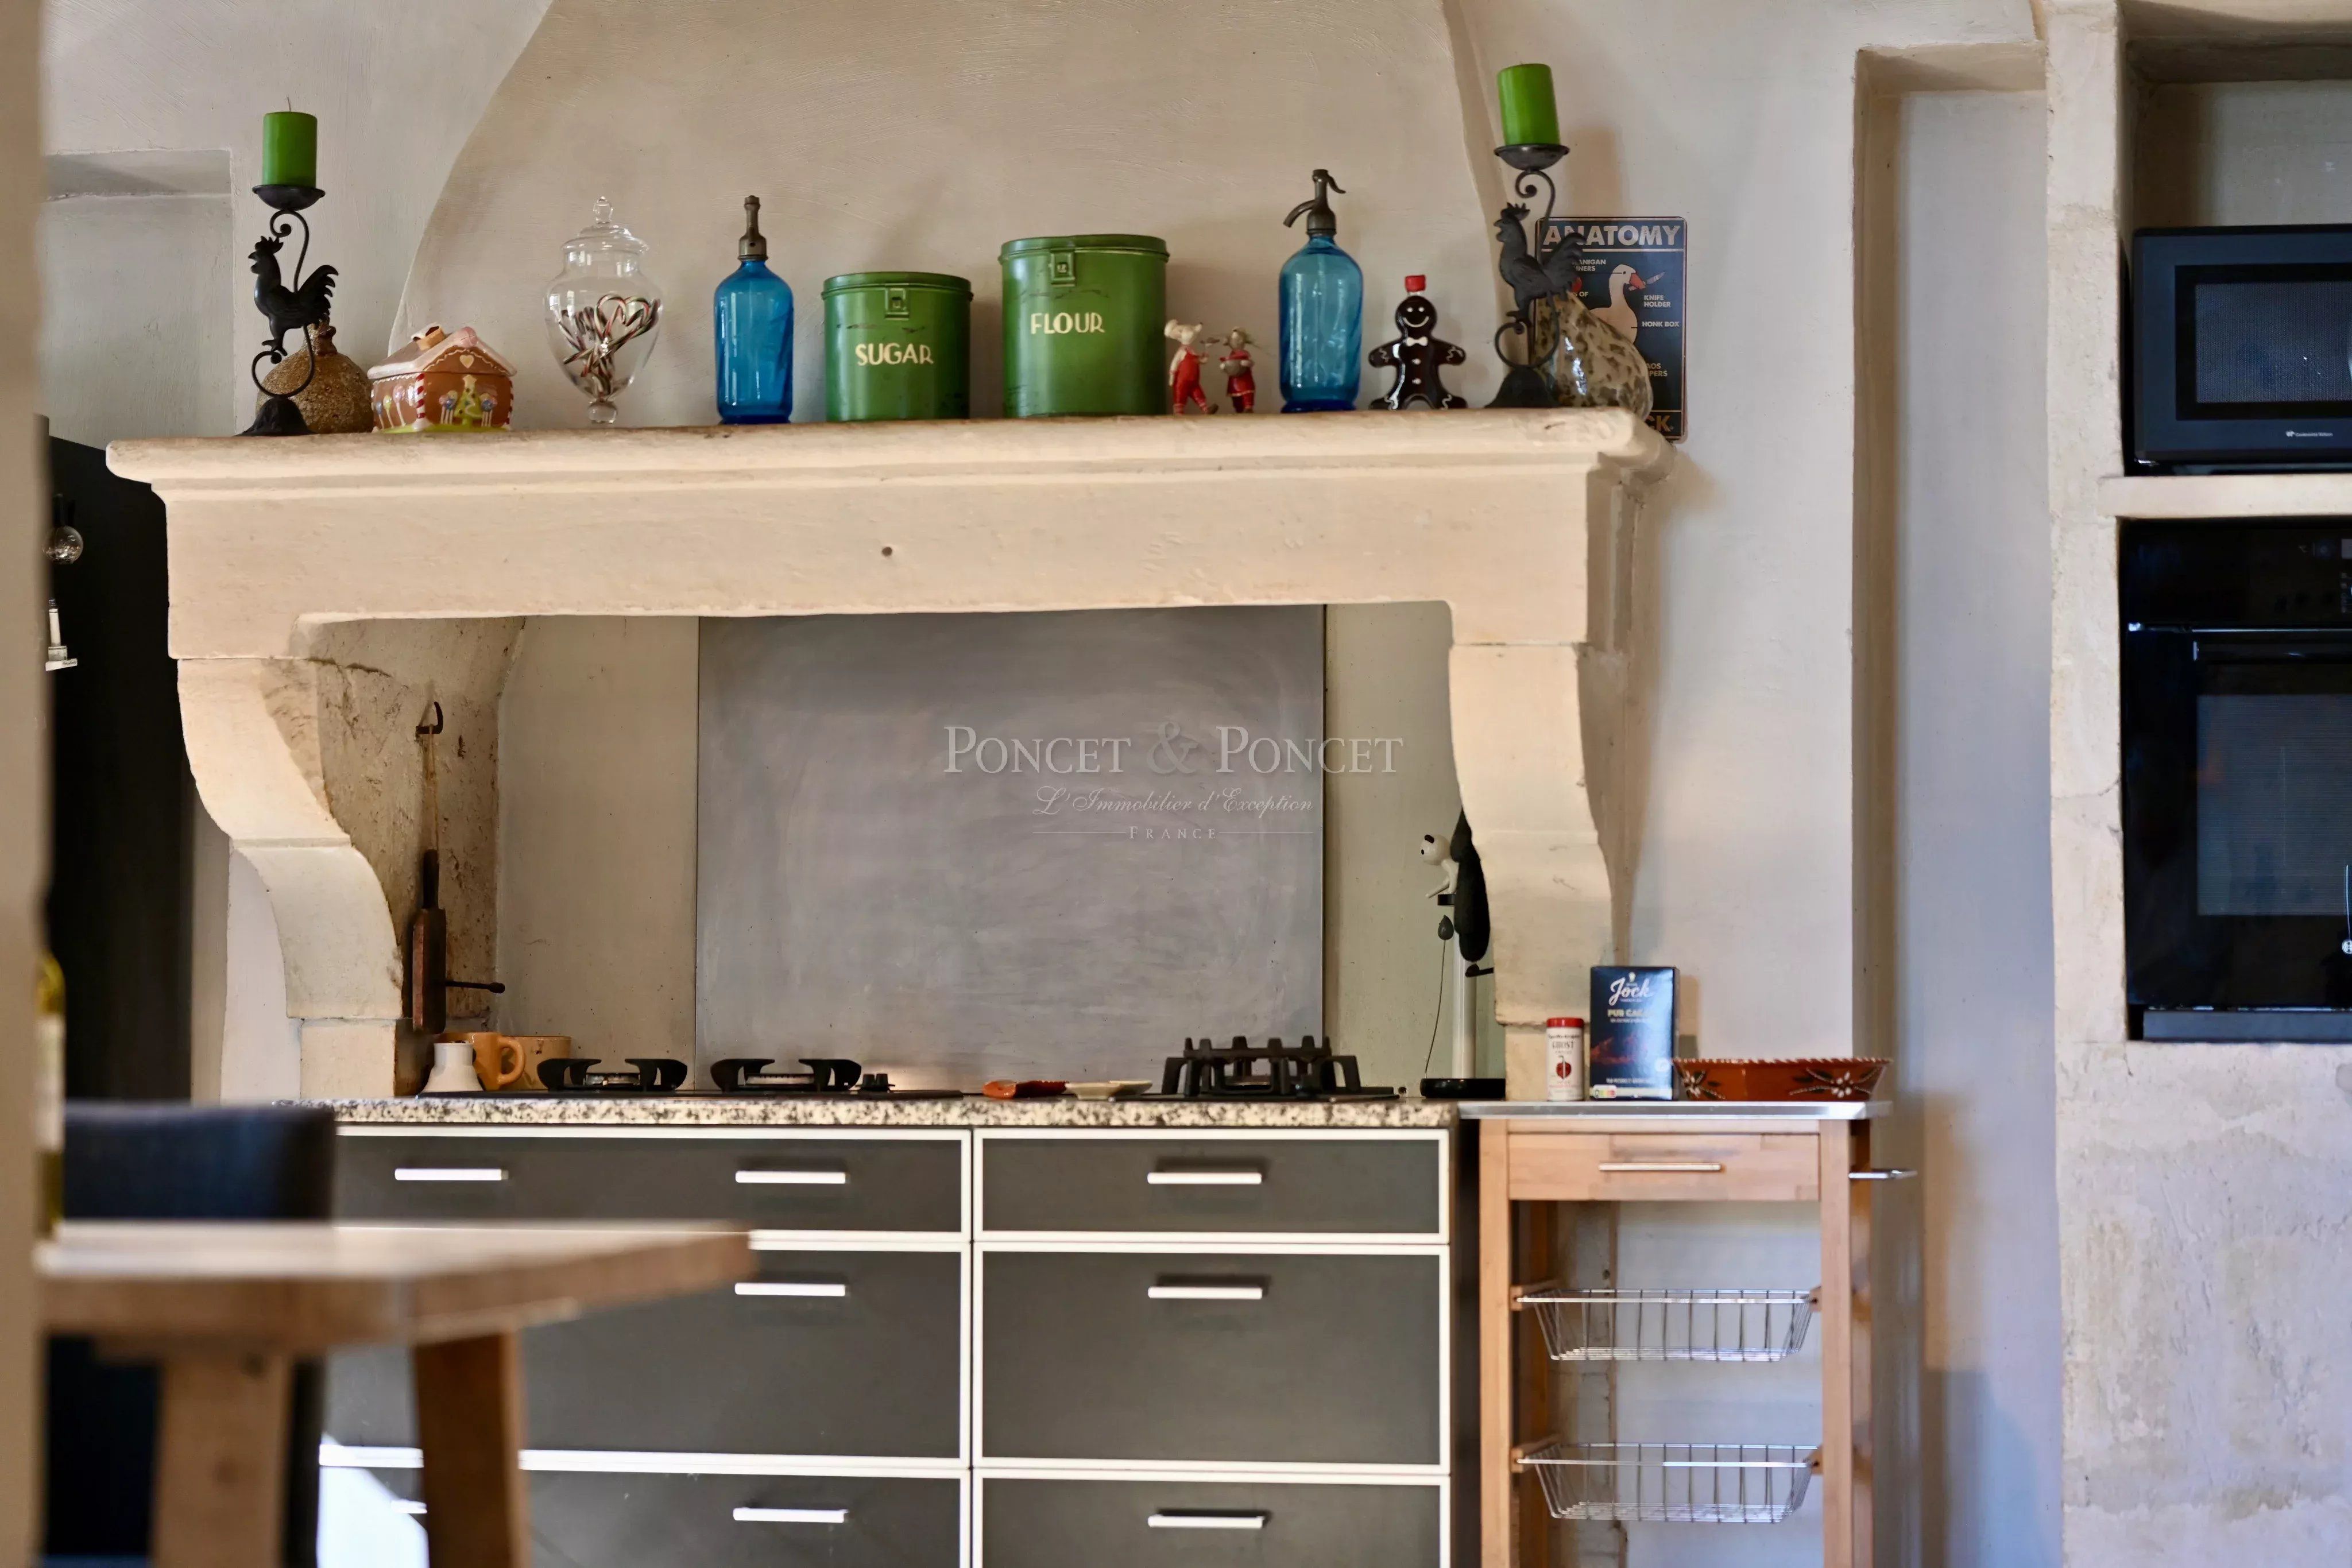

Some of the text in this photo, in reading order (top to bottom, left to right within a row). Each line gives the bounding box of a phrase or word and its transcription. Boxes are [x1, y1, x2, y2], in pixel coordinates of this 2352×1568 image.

[1030, 312, 1105, 335] FLOUR
[856, 343, 934, 366] SUGAR
[1608, 977, 1655, 1006] Jock
